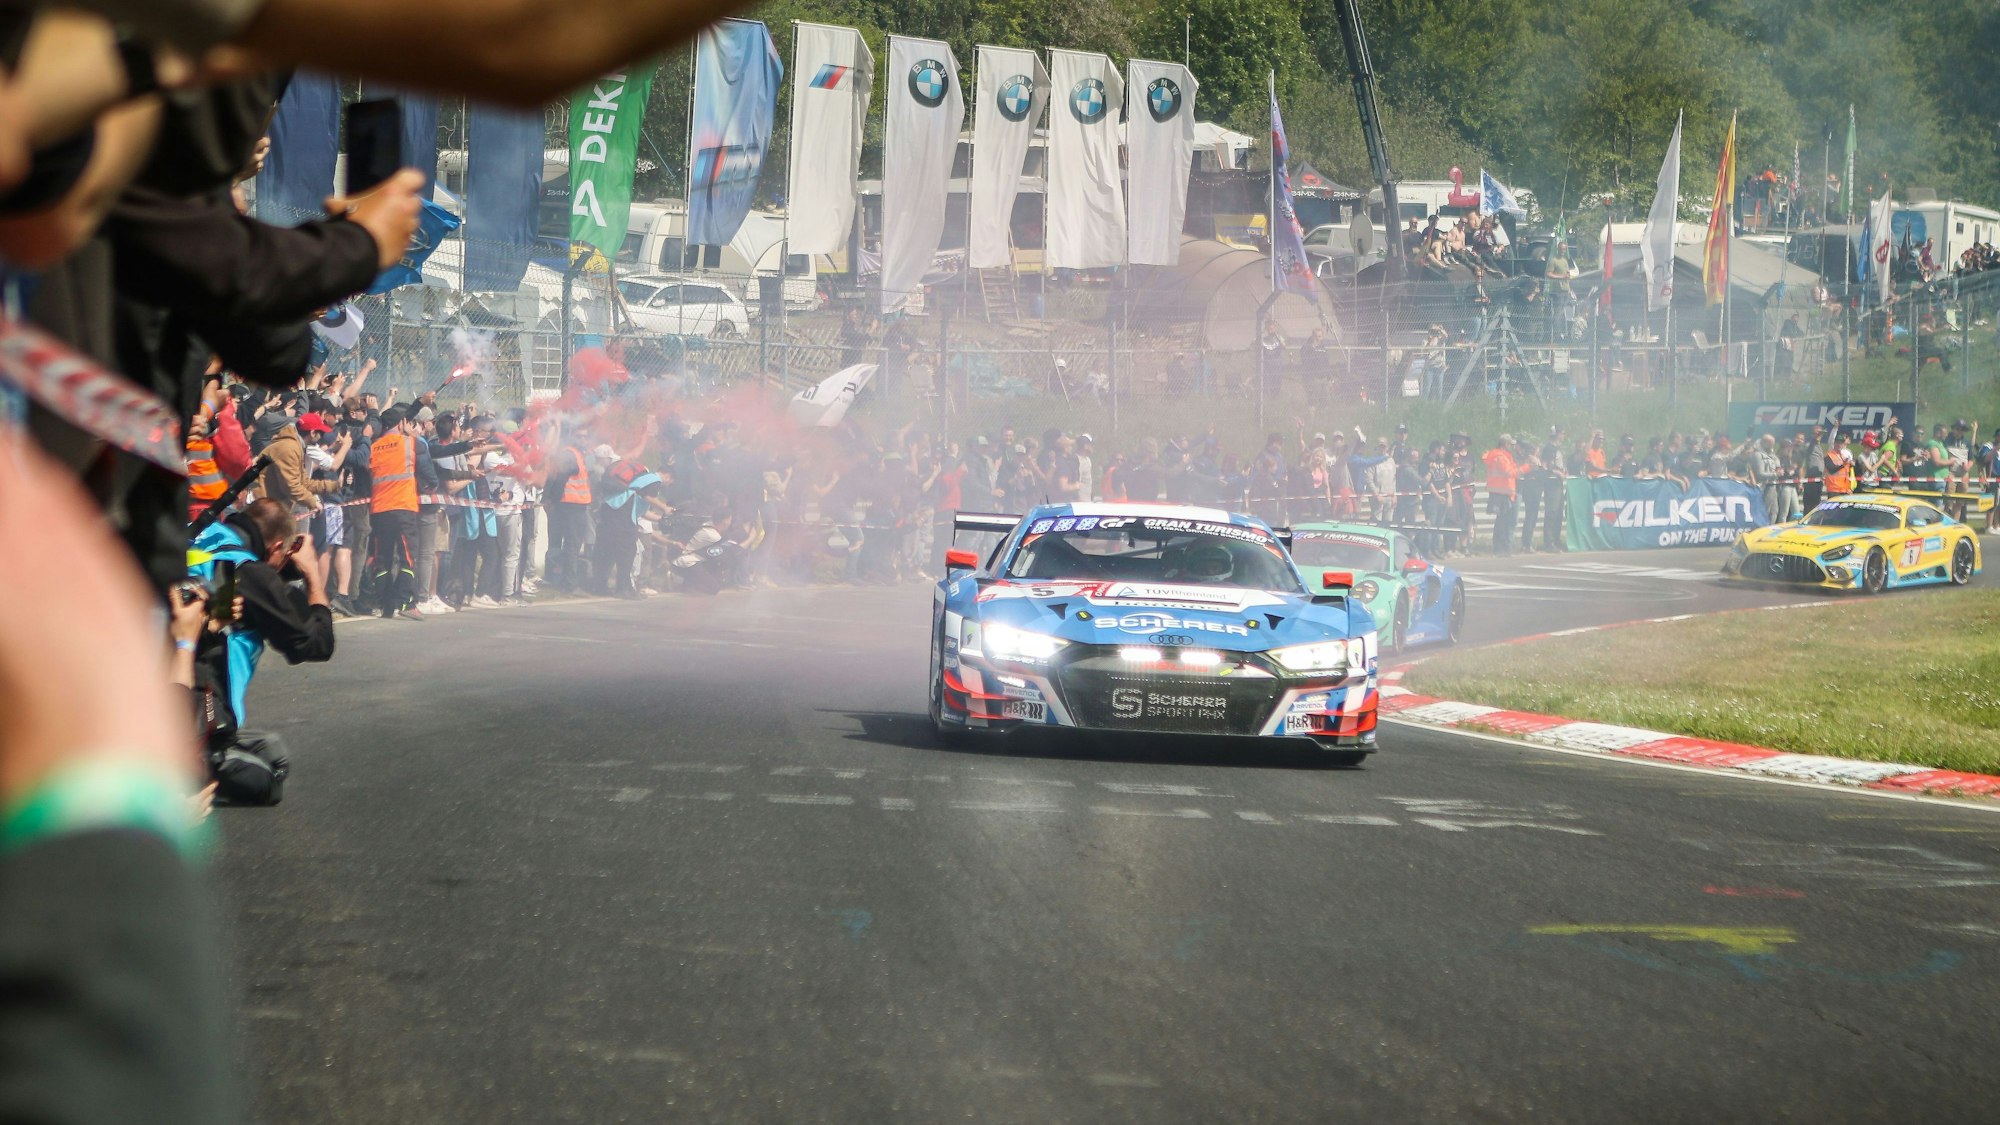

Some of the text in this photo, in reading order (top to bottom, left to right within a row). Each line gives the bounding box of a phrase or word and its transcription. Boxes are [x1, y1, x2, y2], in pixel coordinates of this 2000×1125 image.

[912, 60, 948, 79] BMW
[1147, 79, 1179, 95] BMW
[580, 74, 627, 164] DEK
[547, 189, 569, 197] 24M
[1754, 405, 1893, 426] FALKEN
[1592, 496, 1754, 528] FALKEN
[1144, 518, 1192, 529] GRAN
[1195, 522, 1268, 543] TURISMO
[1186, 528, 1220, 536] DRIVING
[1659, 530, 1683, 547] ON
[1684, 527, 1708, 543] THE
[1031, 587, 1055, 596] 5
[1094, 617, 1248, 637] SCHERER
[1003, 702, 1028, 716] H&R
[1147, 693, 1227, 708] SCHERER
[1286, 714, 1308, 729] H&R
